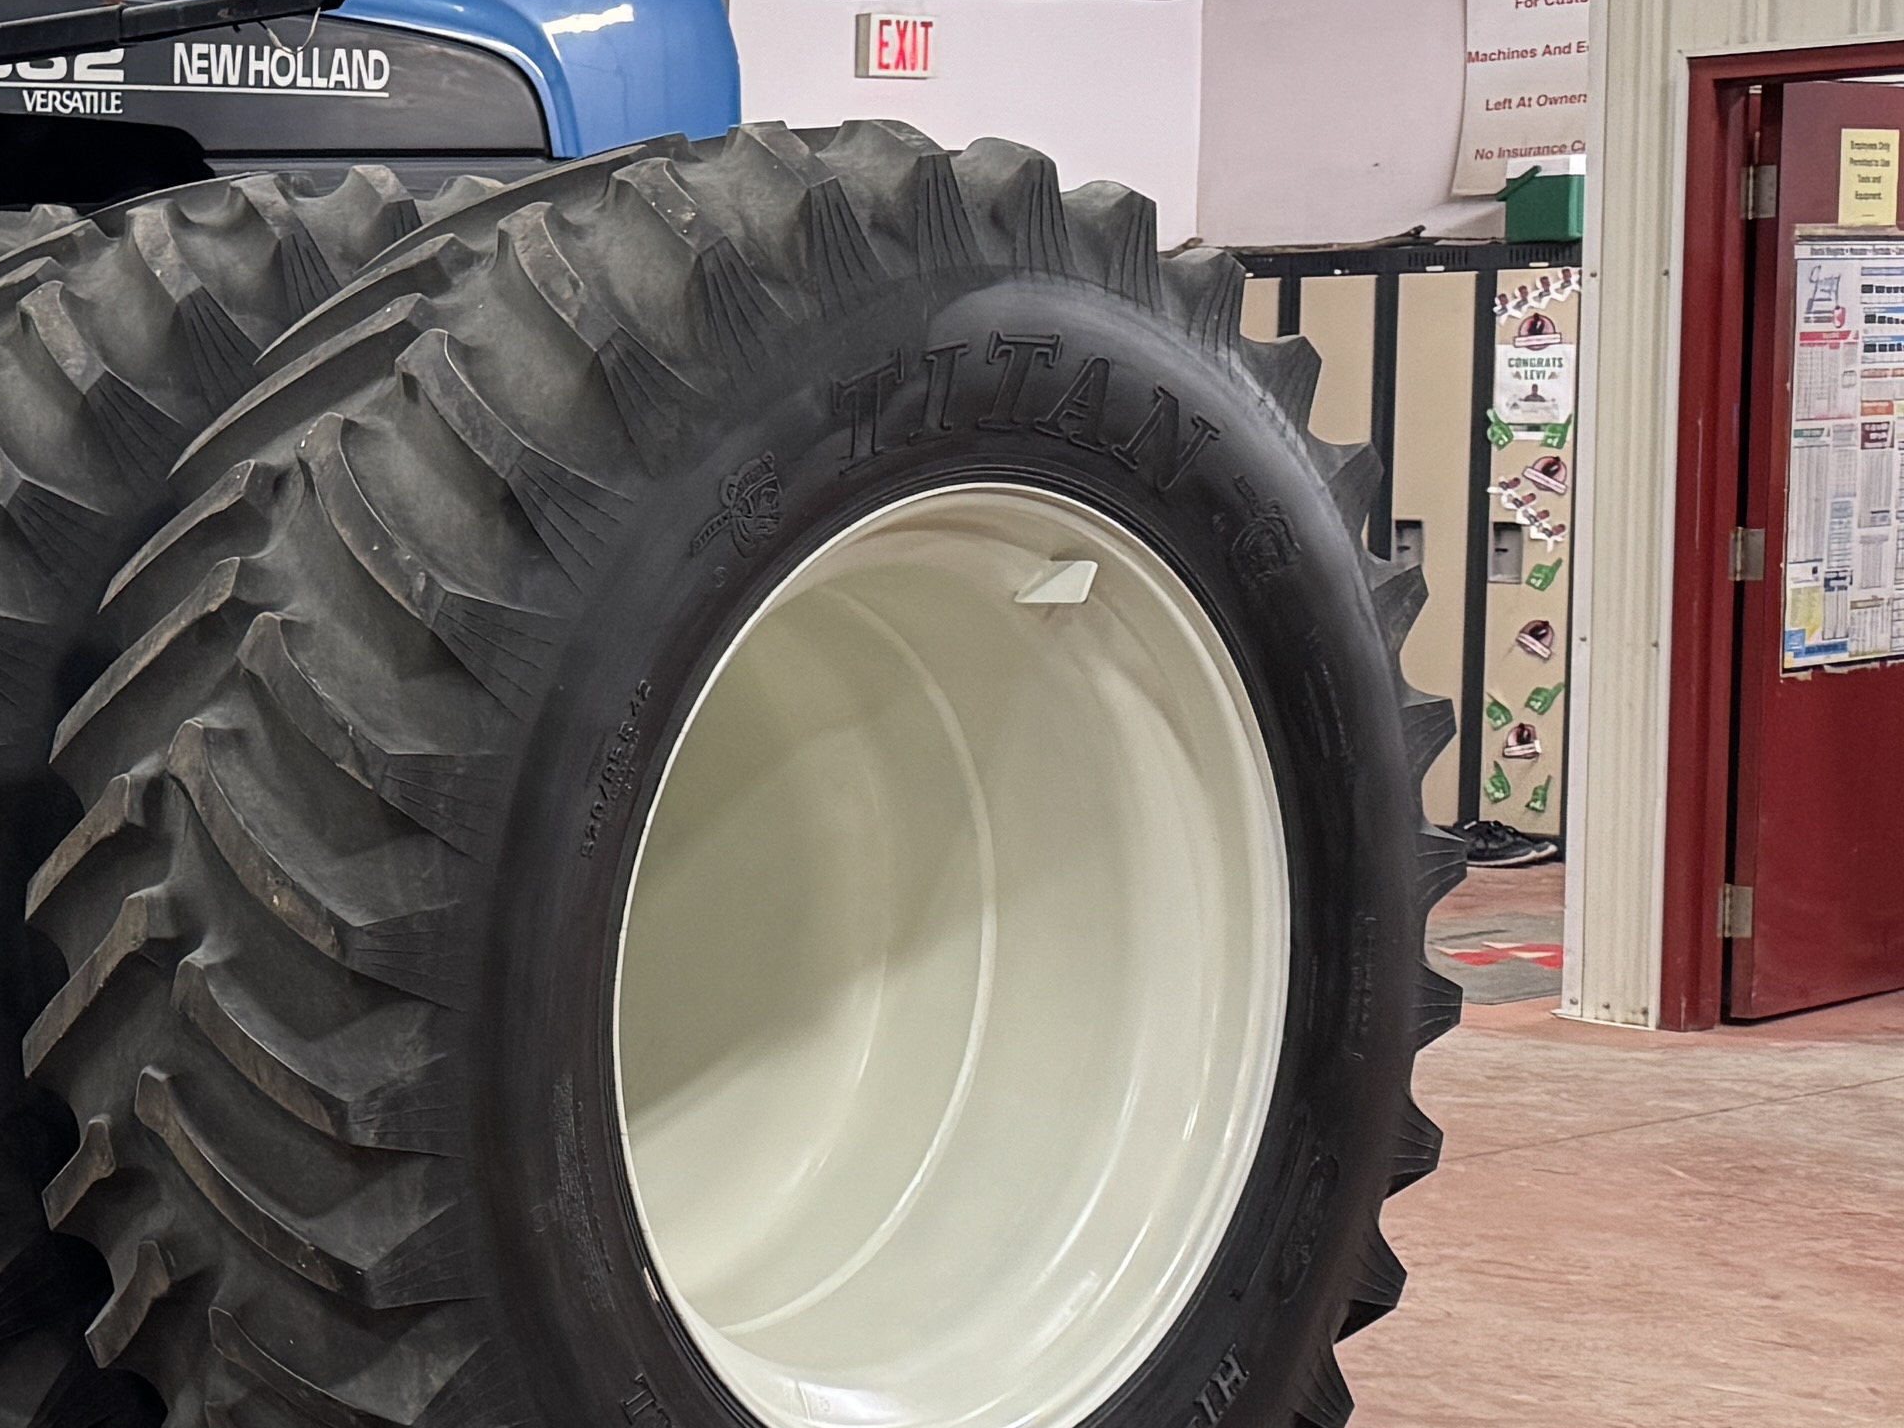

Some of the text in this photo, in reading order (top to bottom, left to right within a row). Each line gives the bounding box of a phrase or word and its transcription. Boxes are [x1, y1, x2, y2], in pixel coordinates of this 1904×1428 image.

[878, 19, 933, 71] EXIT
[1466, 40, 1589, 64] Machines And E
[173, 42, 244, 85] NEW
[247, 45, 390, 90] HOLLAND
[22, 89, 124, 114] VERSATILE
[1485, 98, 1512, 112] Left
[1516, 96, 1533, 109] At
[1474, 148, 1494, 161] No
[1497, 143, 1567, 159] Insurance
[1507, 357, 1564, 368] CONGRATS
[832, 332, 1221, 498] TITAN
